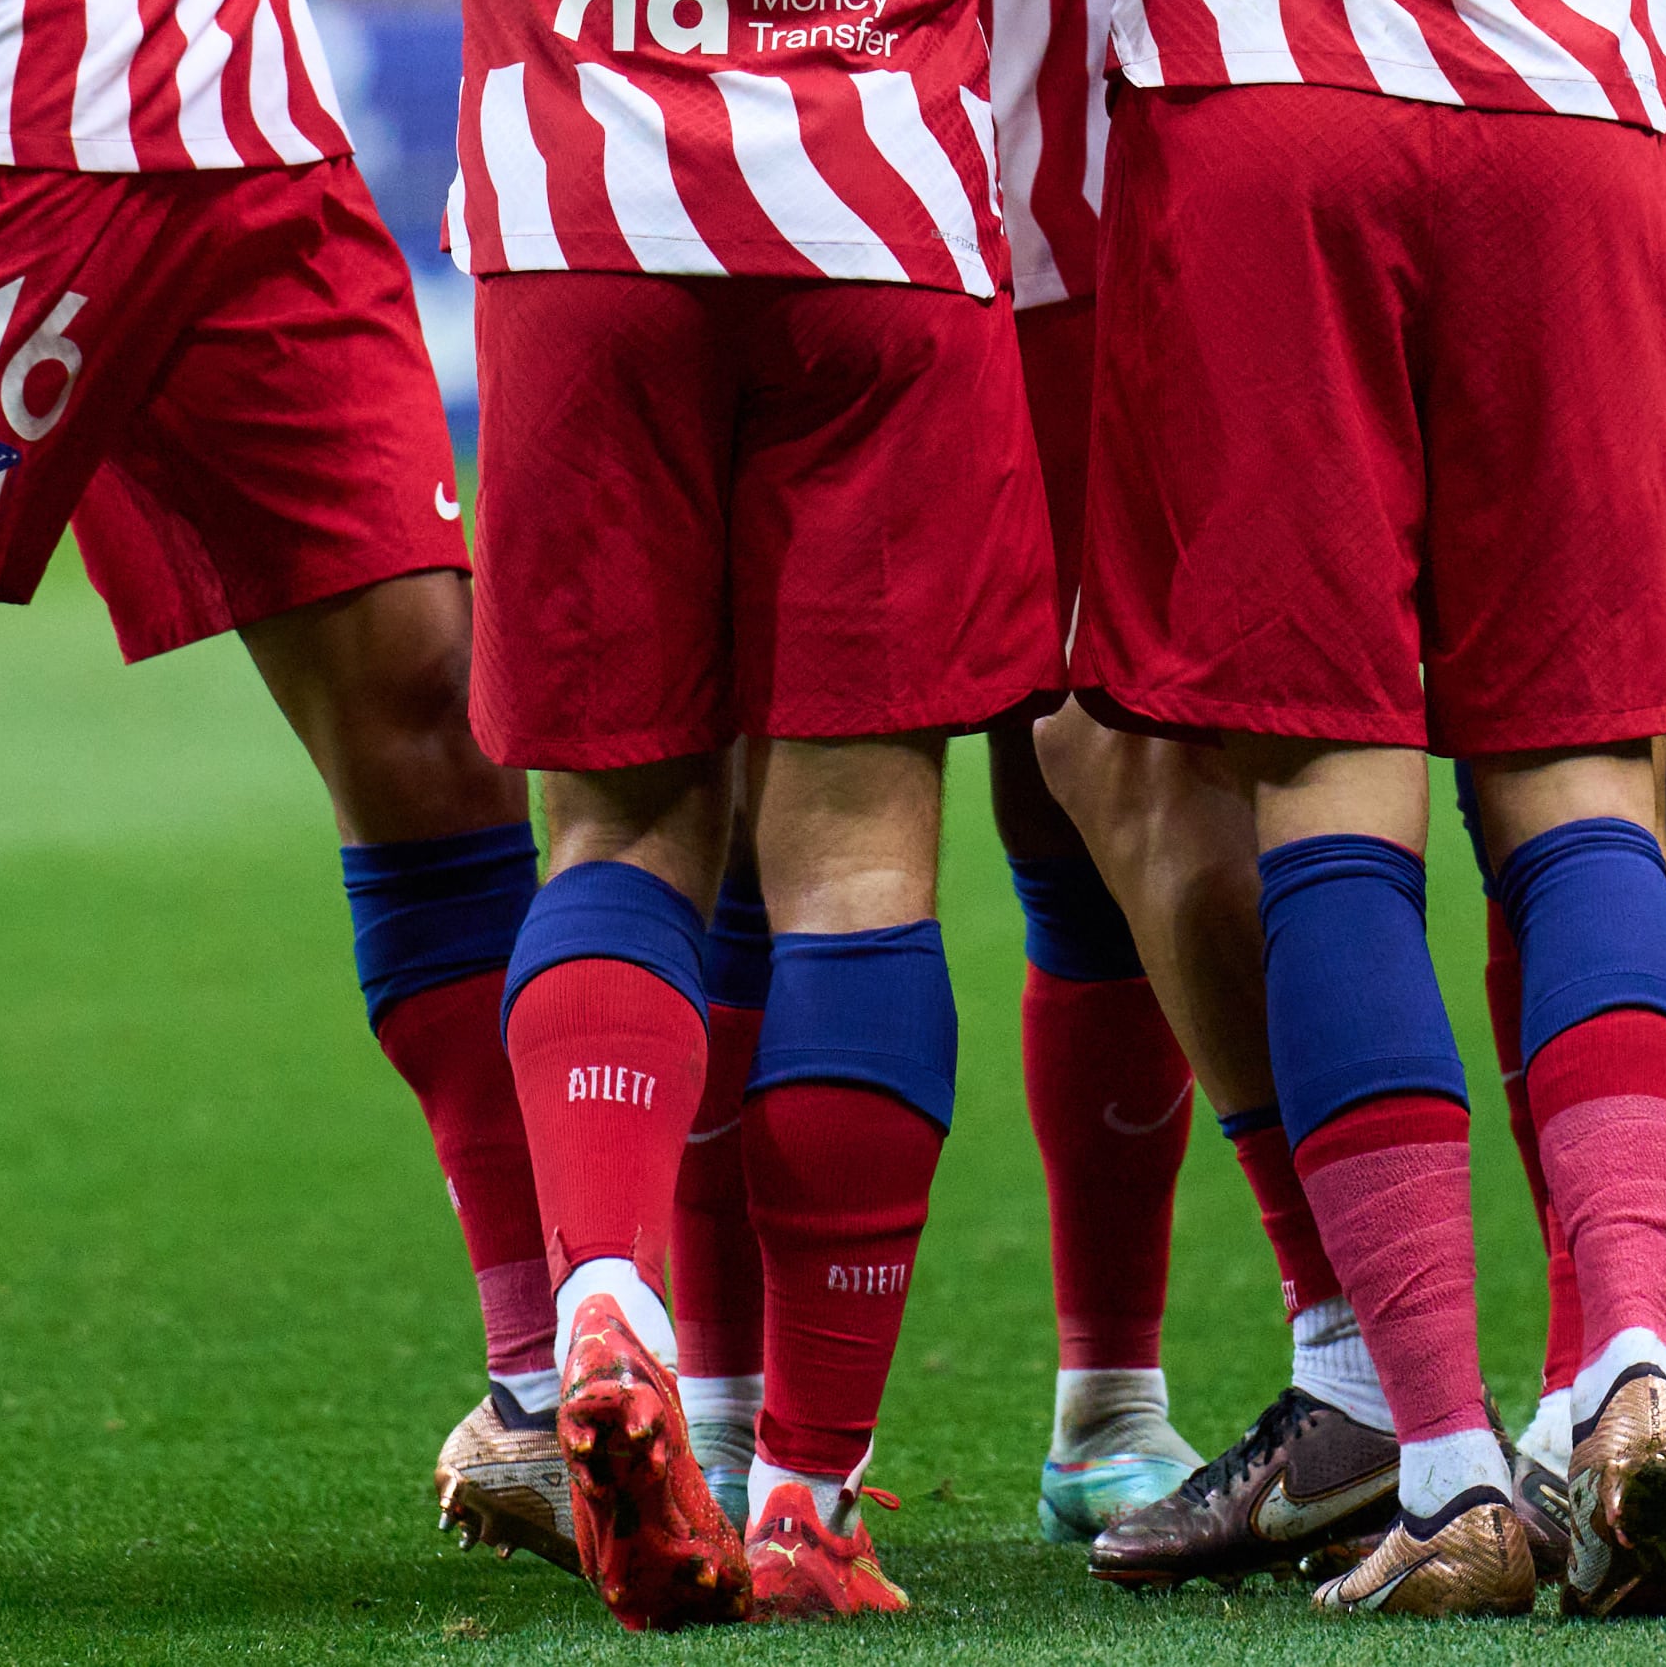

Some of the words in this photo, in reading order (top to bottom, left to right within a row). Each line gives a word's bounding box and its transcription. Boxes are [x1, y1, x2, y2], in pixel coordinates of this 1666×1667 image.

[748, 17, 899, 57] Transfer
[568, 1065, 656, 1110] ATLETI
[828, 1264, 905, 1295] ATLETI
